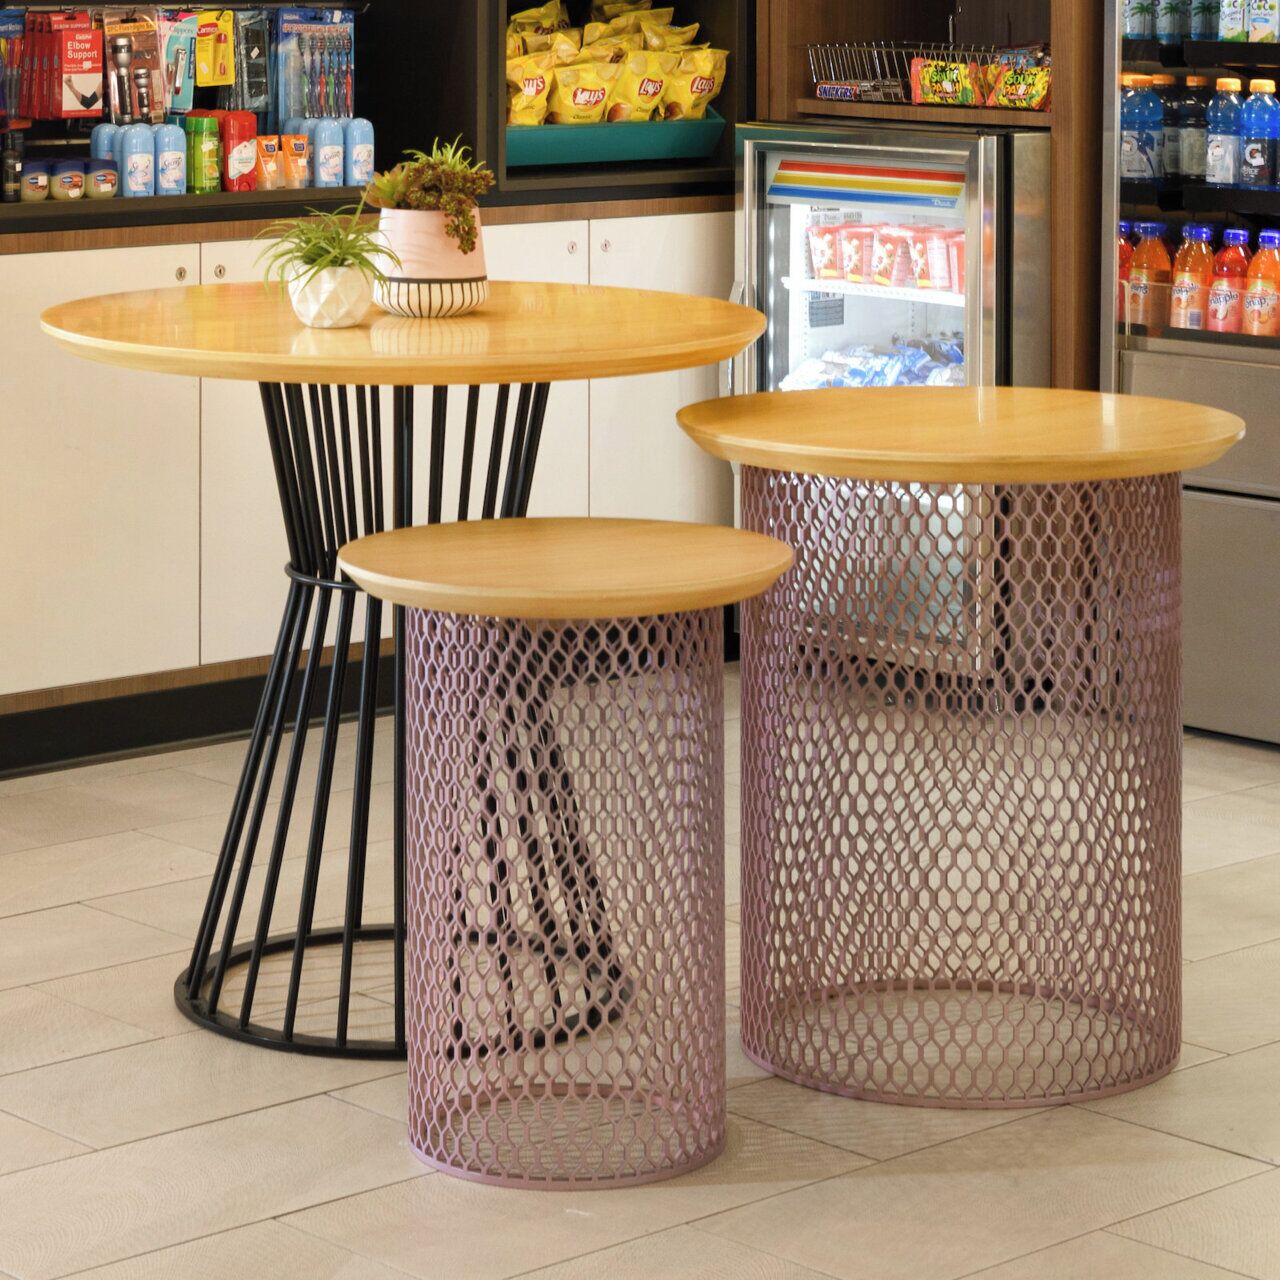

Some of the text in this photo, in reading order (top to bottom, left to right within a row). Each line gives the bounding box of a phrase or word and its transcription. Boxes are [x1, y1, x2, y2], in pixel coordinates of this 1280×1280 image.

[67, 41, 91, 50] Elbow
[67, 50, 98, 60] Support
[639, 78, 663, 97] Lay's
[692, 76, 715, 95] Lay's
